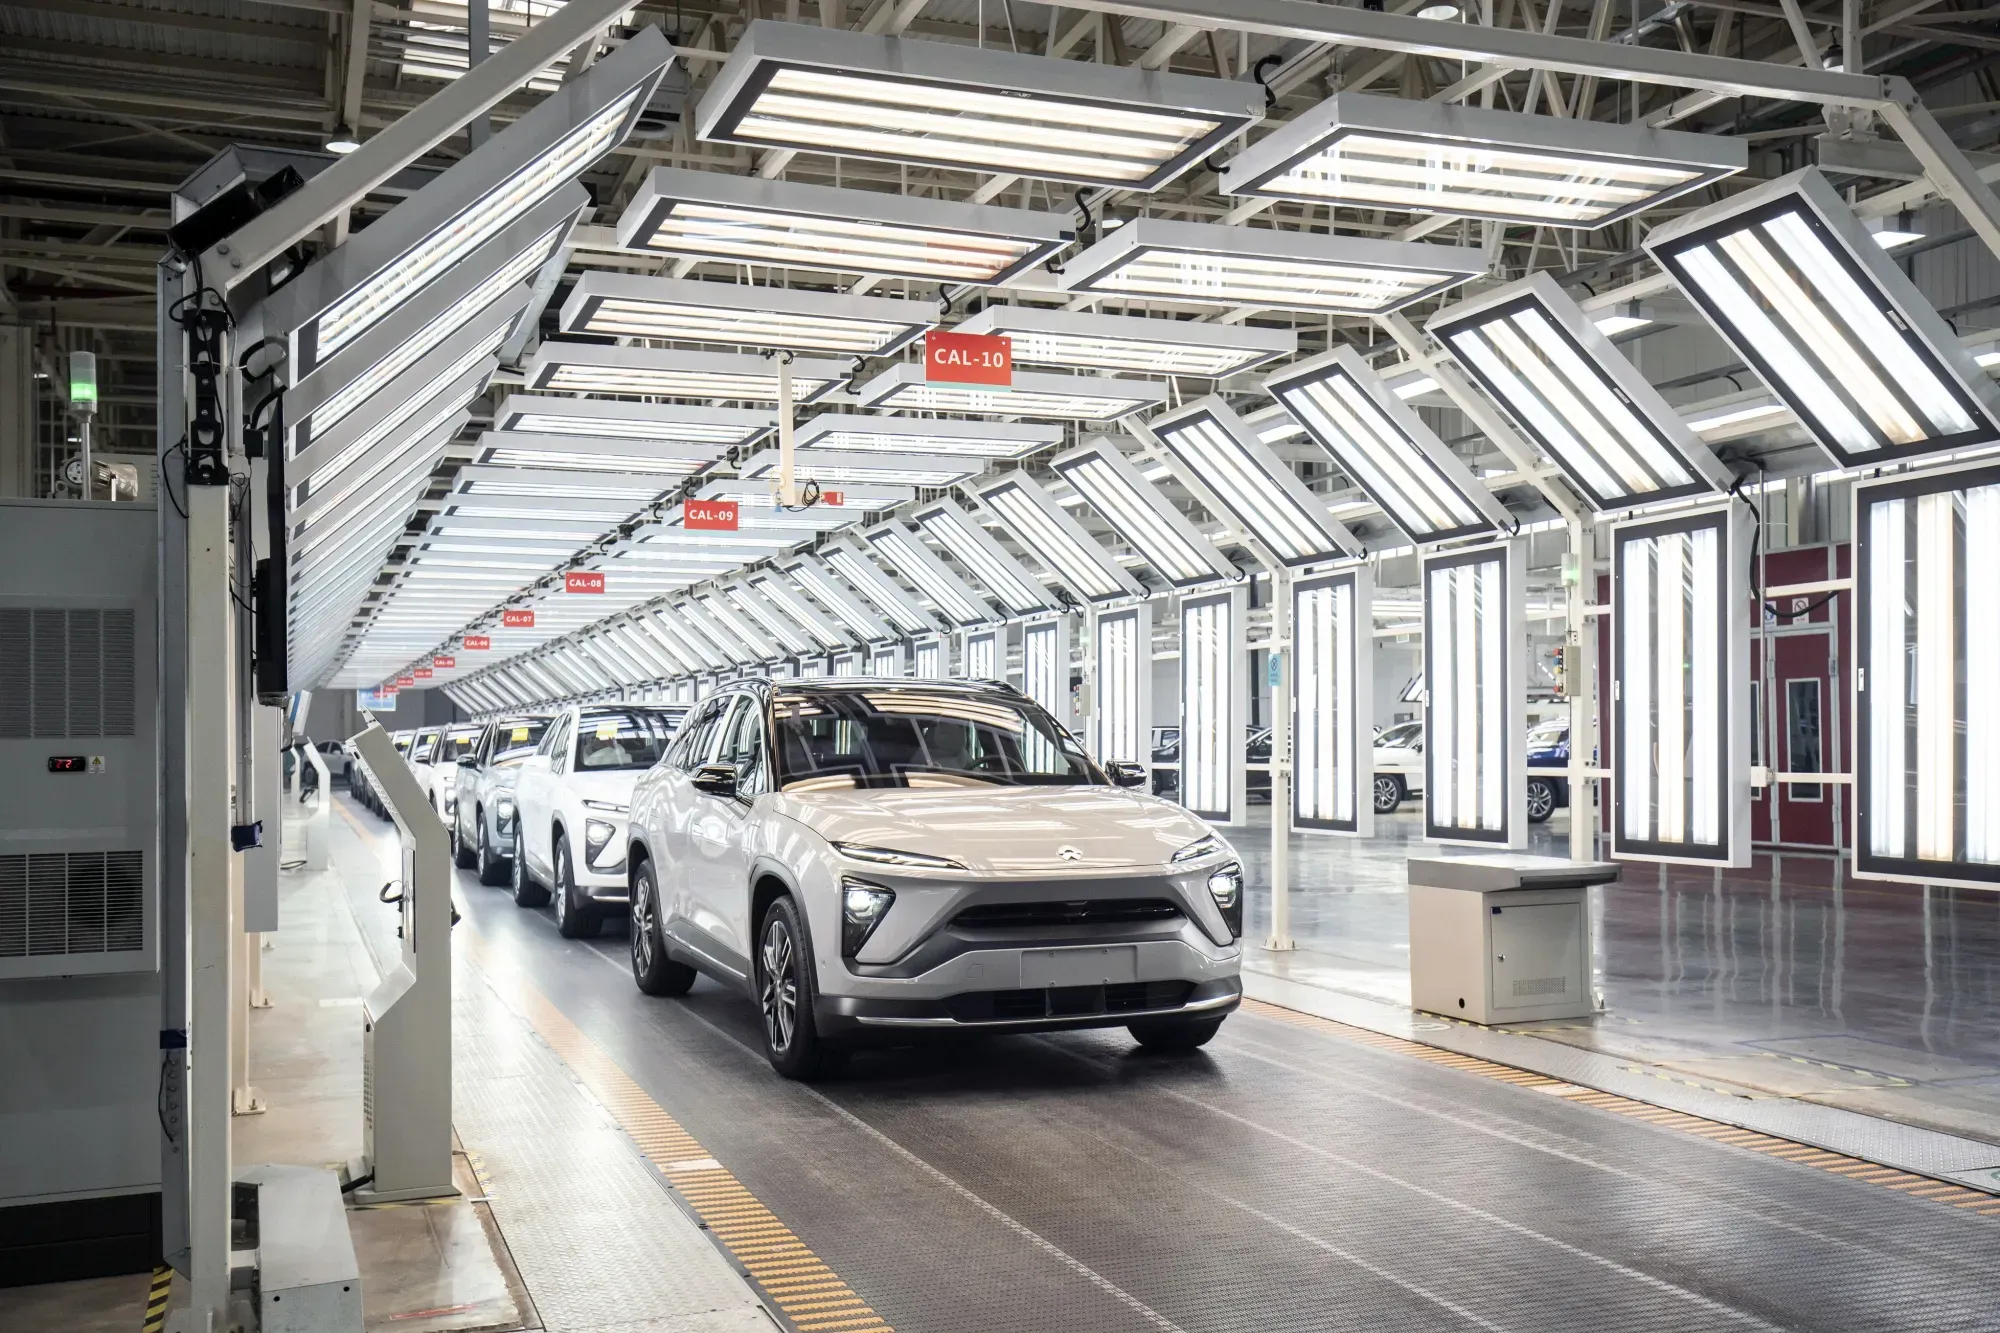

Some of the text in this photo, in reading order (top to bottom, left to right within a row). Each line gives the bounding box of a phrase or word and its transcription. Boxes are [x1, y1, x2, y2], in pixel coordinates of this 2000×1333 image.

[934, 348, 1004, 368] CAL-10
[689, 509, 734, 521] CAL-09
[569, 579, 602, 588] CAL-08
[506, 615, 532, 623] CAL-07
